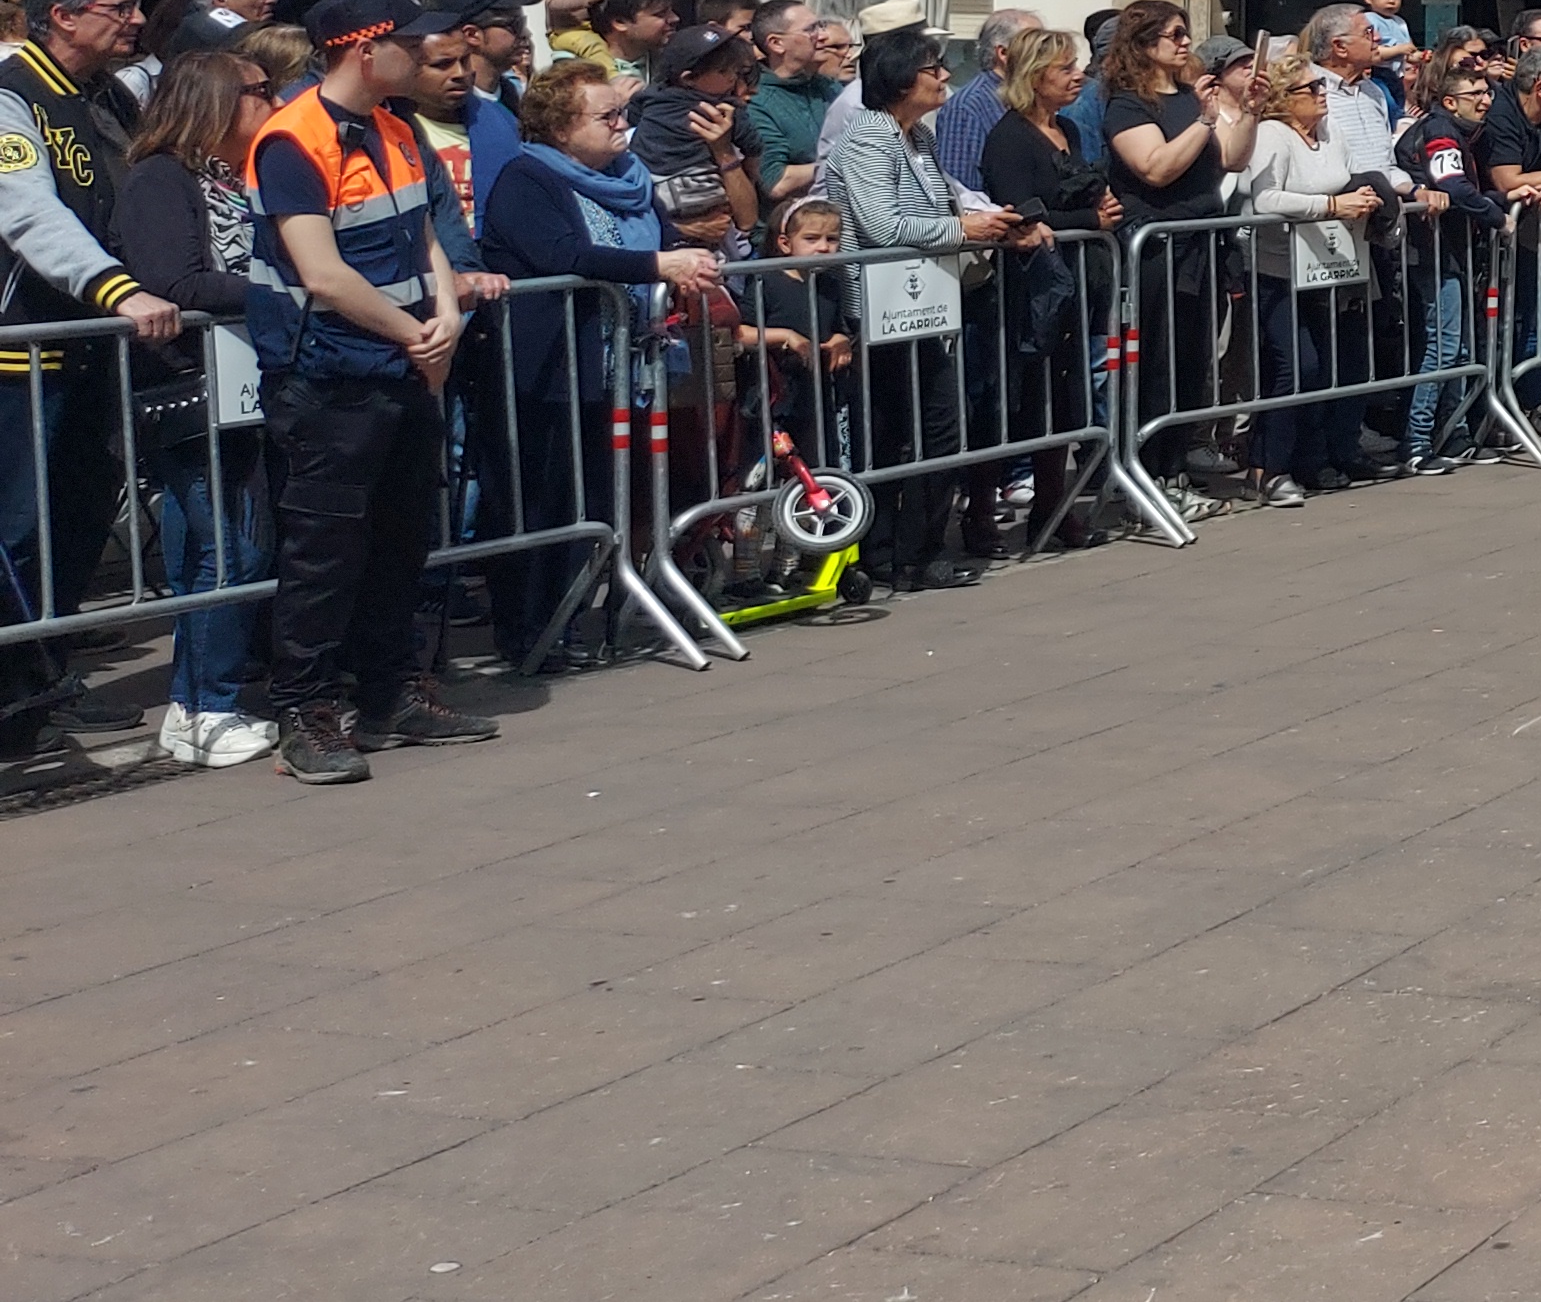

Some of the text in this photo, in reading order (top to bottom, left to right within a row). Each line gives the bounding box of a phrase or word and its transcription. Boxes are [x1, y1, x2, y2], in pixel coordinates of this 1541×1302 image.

[33, 102, 94, 186] NYC
[1434, 151, 1462, 174] 73
[882, 304, 948, 323] Ajuntament de
[882, 316, 948, 335] LA GARRIGA
